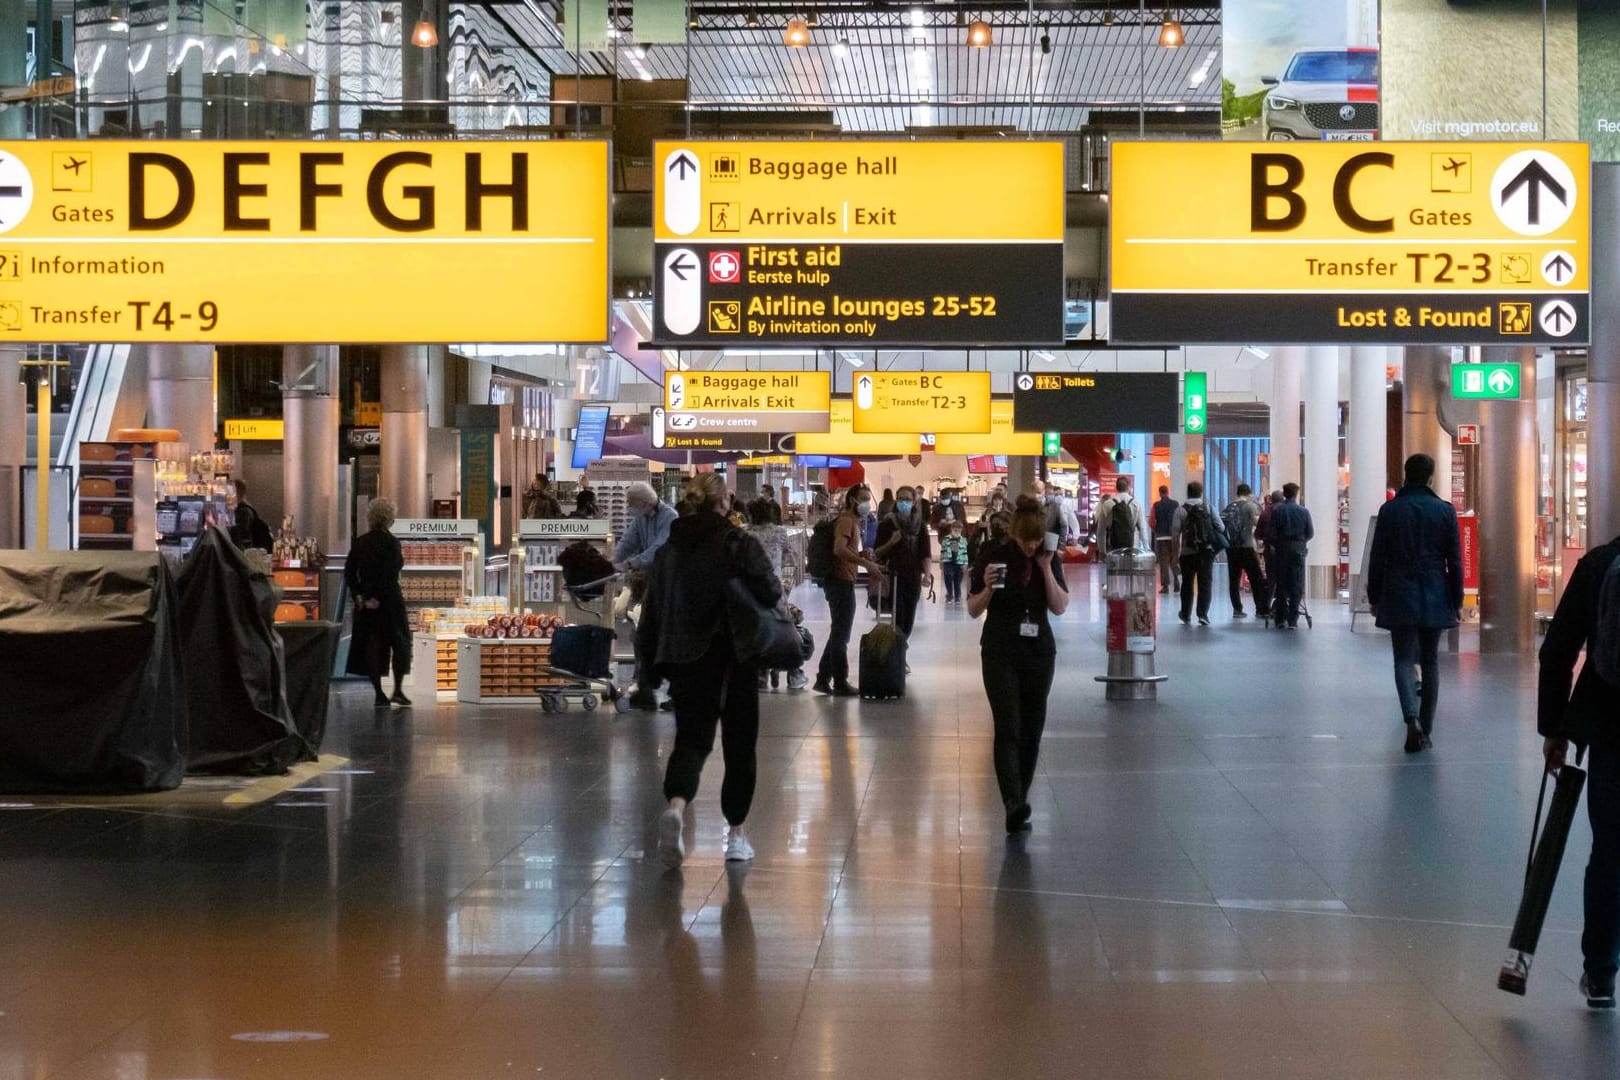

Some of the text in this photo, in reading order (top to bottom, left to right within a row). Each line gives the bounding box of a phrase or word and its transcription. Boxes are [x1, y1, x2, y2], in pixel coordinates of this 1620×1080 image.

[1411, 119, 1538, 136] Visit mgmotor.eu
[750, 157, 896, 178] Baggage hall
[52, 205, 113, 222] Gates
[749, 207, 896, 225] Arrivals Exit
[1410, 209, 1472, 225] Gates
[749, 246, 840, 266] First aid
[32, 256, 163, 274] Information
[1305, 253, 1491, 283] Transfer T2-3
[749, 270, 829, 285] Eerste hulp
[30, 301, 218, 331] Transfer T4-9
[748, 296, 996, 321] Airline lounges 25-52
[1338, 307, 1491, 326] Lost & Found
[749, 320, 876, 335] By invitation only
[704, 375, 798, 390] Baggage hall
[1063, 378, 1095, 387] Toilets
[703, 395, 794, 407] Arrivals Exit
[892, 396, 965, 408] Transfer T2-3
[243, 425, 257, 433] Lift
[700, 418, 725, 427] Crew
[677, 438, 692, 446] Lost
[701, 438, 723, 446] found
[409, 523, 458, 532] PREMIUM
[541, 523, 589, 532] PREMIUM
